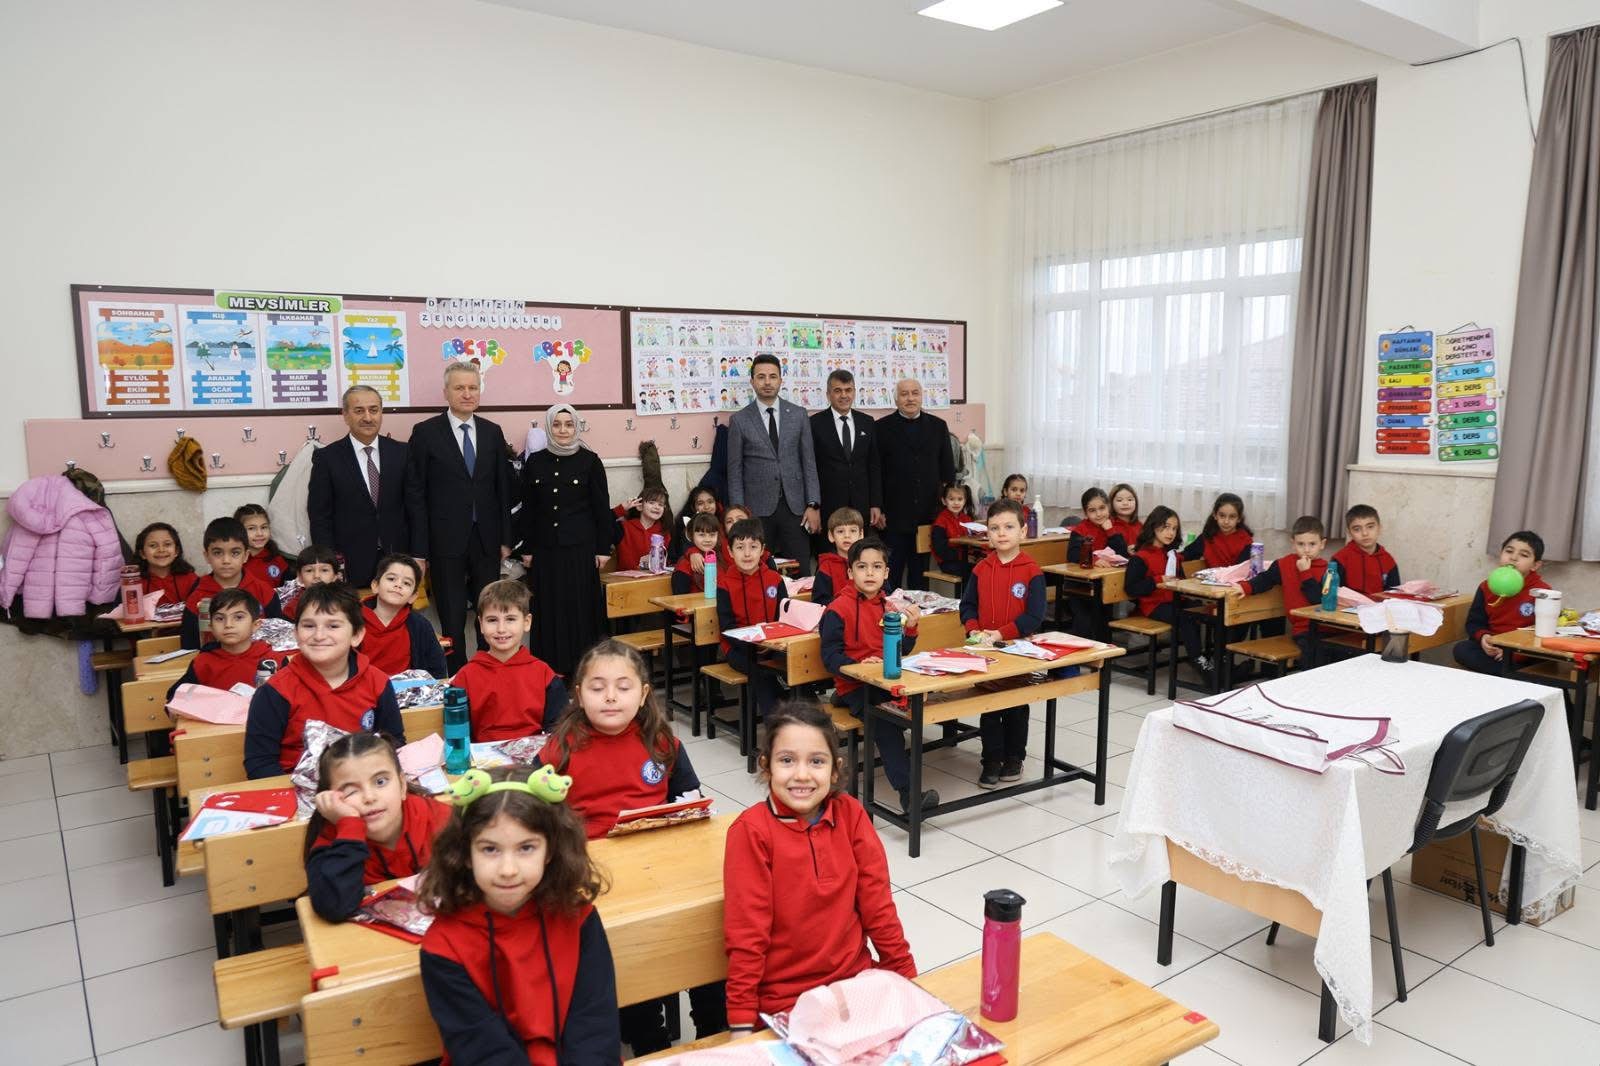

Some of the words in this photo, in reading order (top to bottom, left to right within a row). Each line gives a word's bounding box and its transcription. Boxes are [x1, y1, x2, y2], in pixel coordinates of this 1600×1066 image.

[229, 296, 331, 312] MEVSİMLER
[111, 309, 156, 317] SONBAHAR
[442, 338, 475, 360] ABC
[476, 339, 508, 366] 123
[533, 341, 563, 362] ABC
[563, 339, 593, 363] 123
[1462, 367, 1480, 376] DERS
[1464, 384, 1482, 392] DERS
[1463, 400, 1481, 408] DERS
[1462, 416, 1481, 424] DERS
[1463, 432, 1481, 440] DERS
[1464, 448, 1482, 456] DERS
